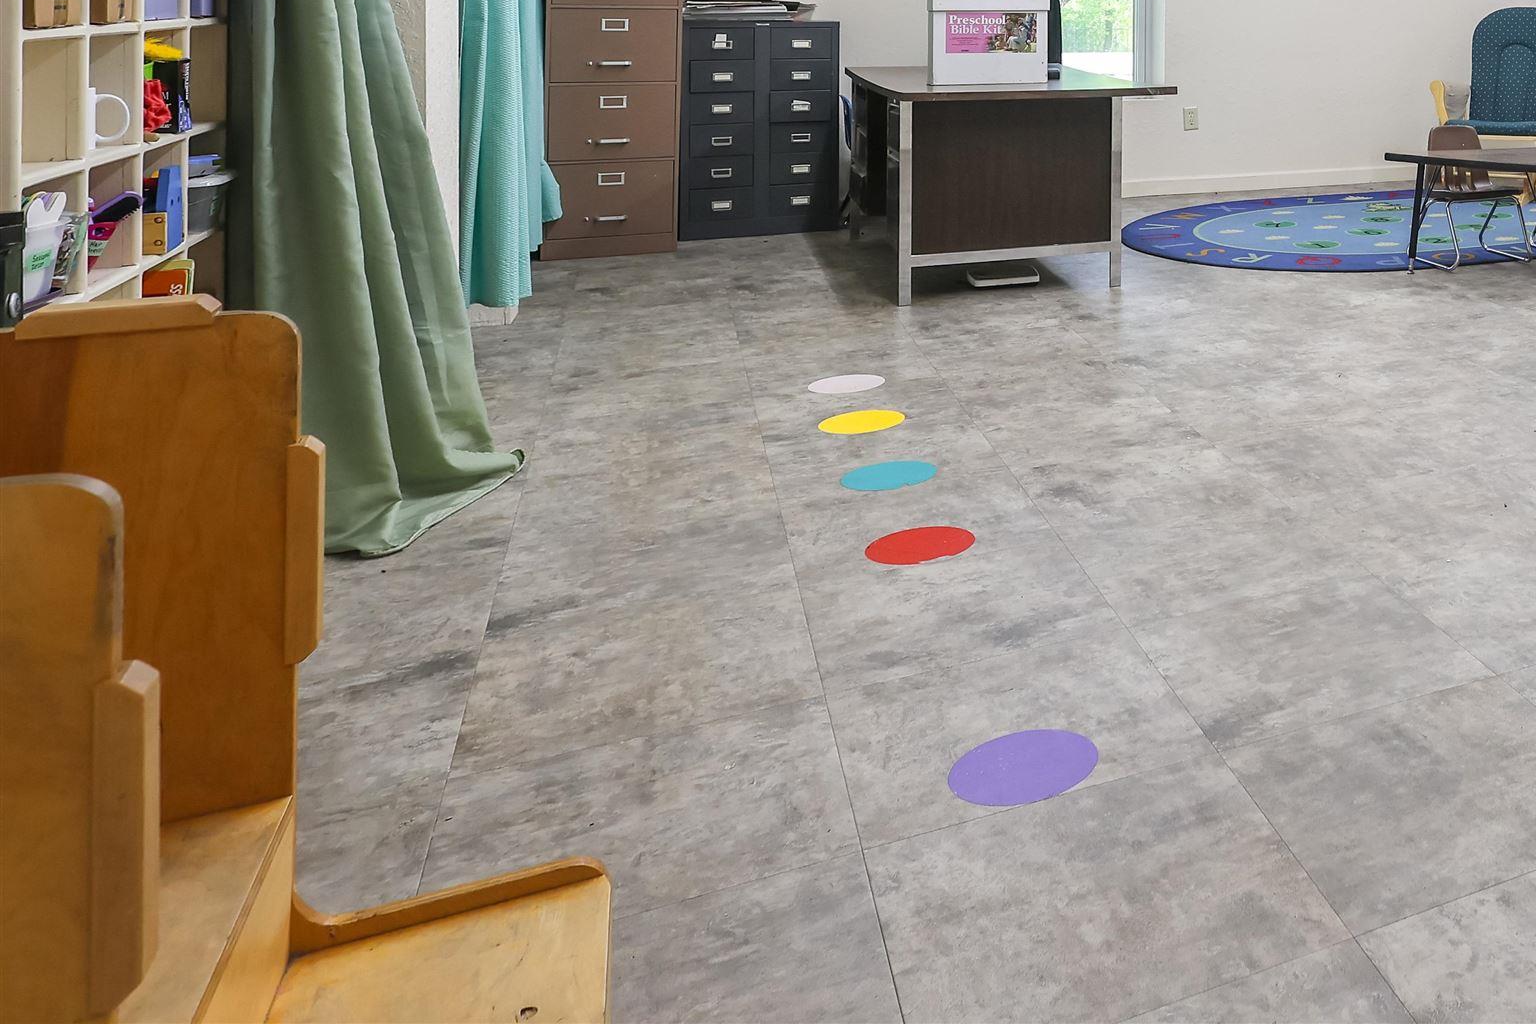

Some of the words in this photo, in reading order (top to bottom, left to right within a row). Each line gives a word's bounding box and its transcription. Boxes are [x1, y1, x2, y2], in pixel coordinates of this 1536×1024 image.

[949, 14, 1006, 25] Preschool
[950, 24, 979, 35] Bible
[983, 24, 1002, 35] Kit
